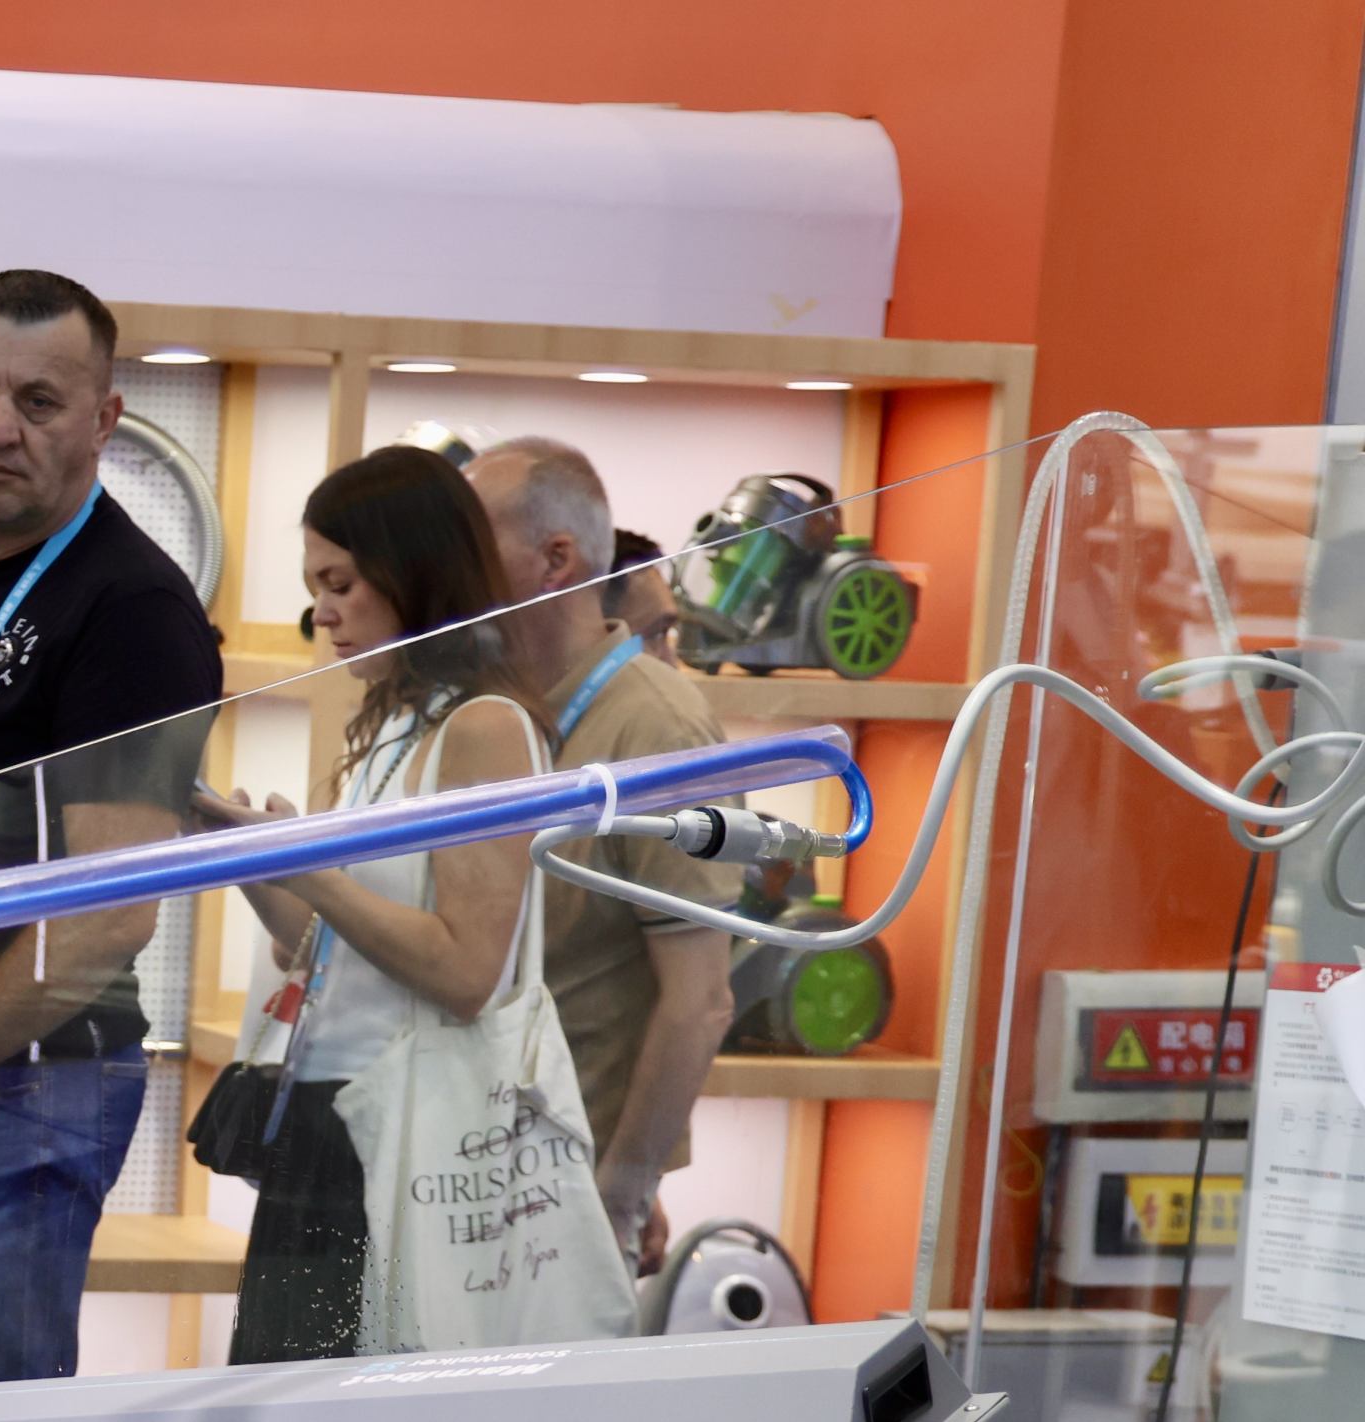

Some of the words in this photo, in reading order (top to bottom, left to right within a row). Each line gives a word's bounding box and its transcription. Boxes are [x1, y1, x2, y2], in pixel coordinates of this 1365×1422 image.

[0, 617, 39, 653] LEIN
[411, 1167, 506, 1206] GIRLS
[407, 1350, 572, 1367] SolarWalker
[338, 1362, 554, 1387] Mamibot
